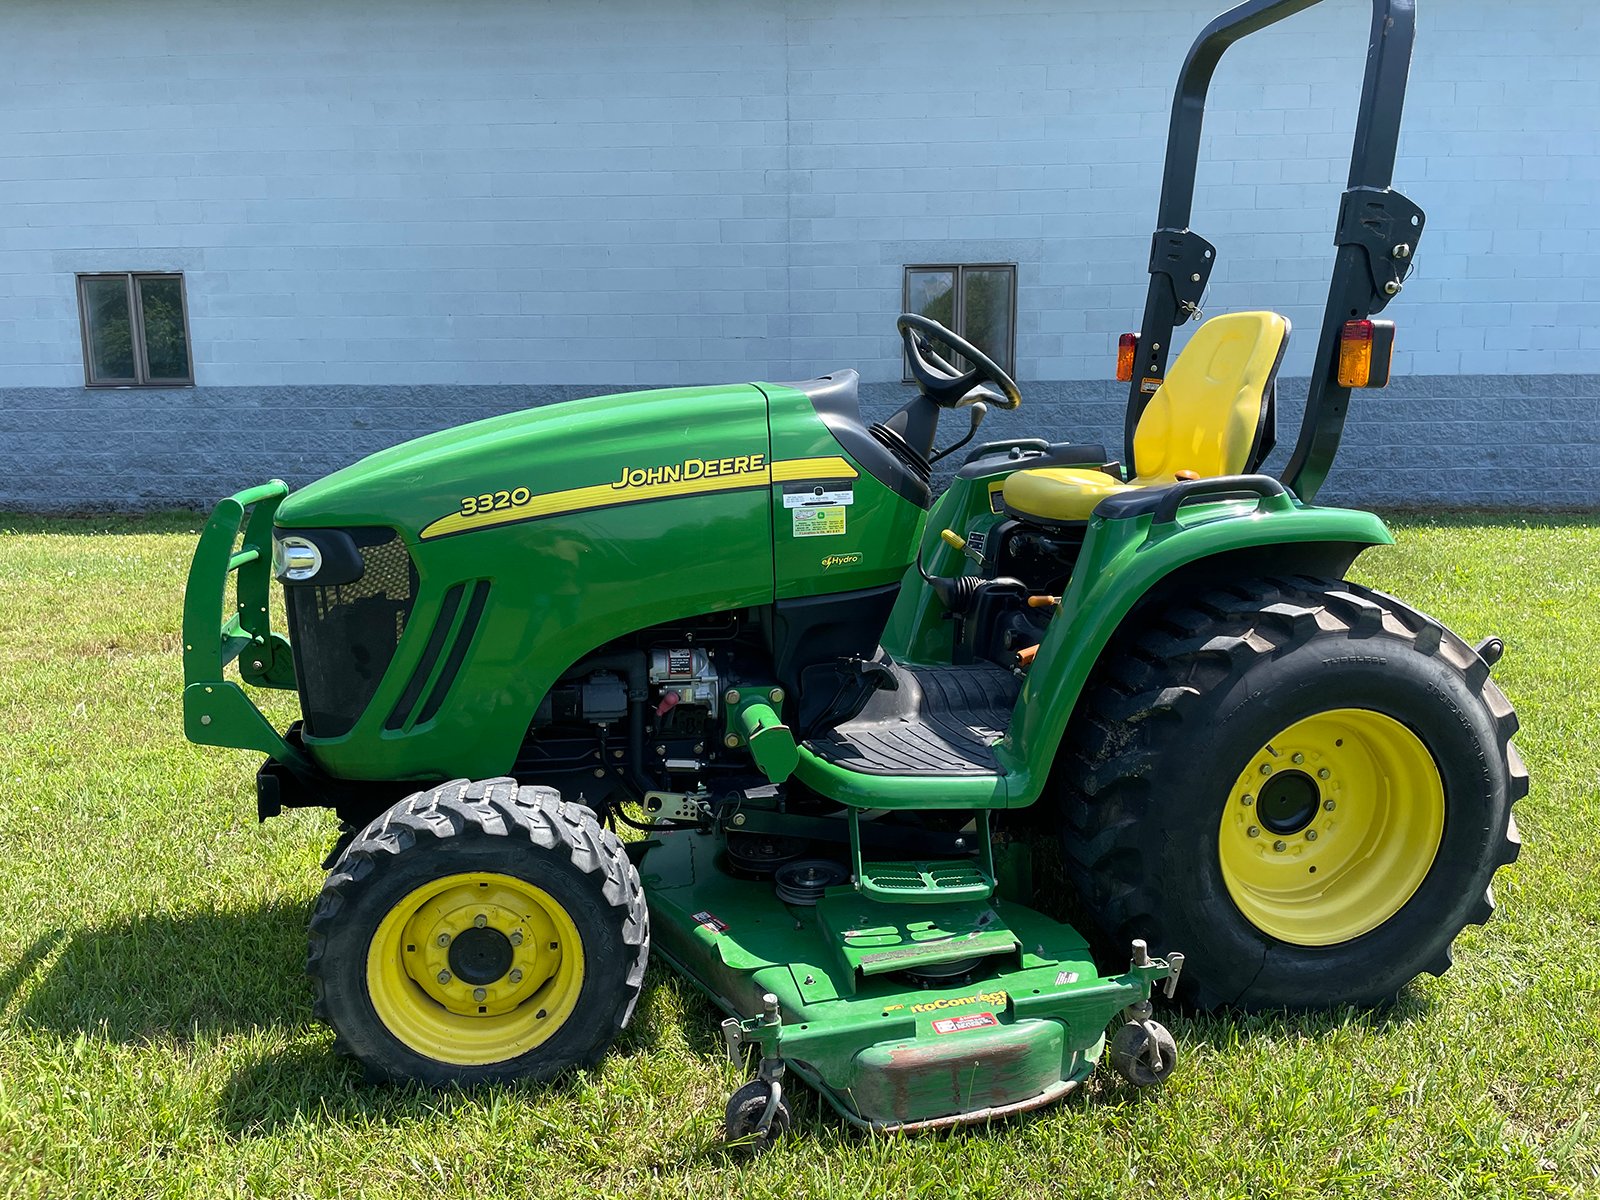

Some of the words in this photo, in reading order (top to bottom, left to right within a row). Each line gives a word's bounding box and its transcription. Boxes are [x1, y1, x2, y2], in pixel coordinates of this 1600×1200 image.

[612, 463, 681, 489] JOHN
[683, 453, 765, 481] DEERE
[461, 487, 531, 516] 3320
